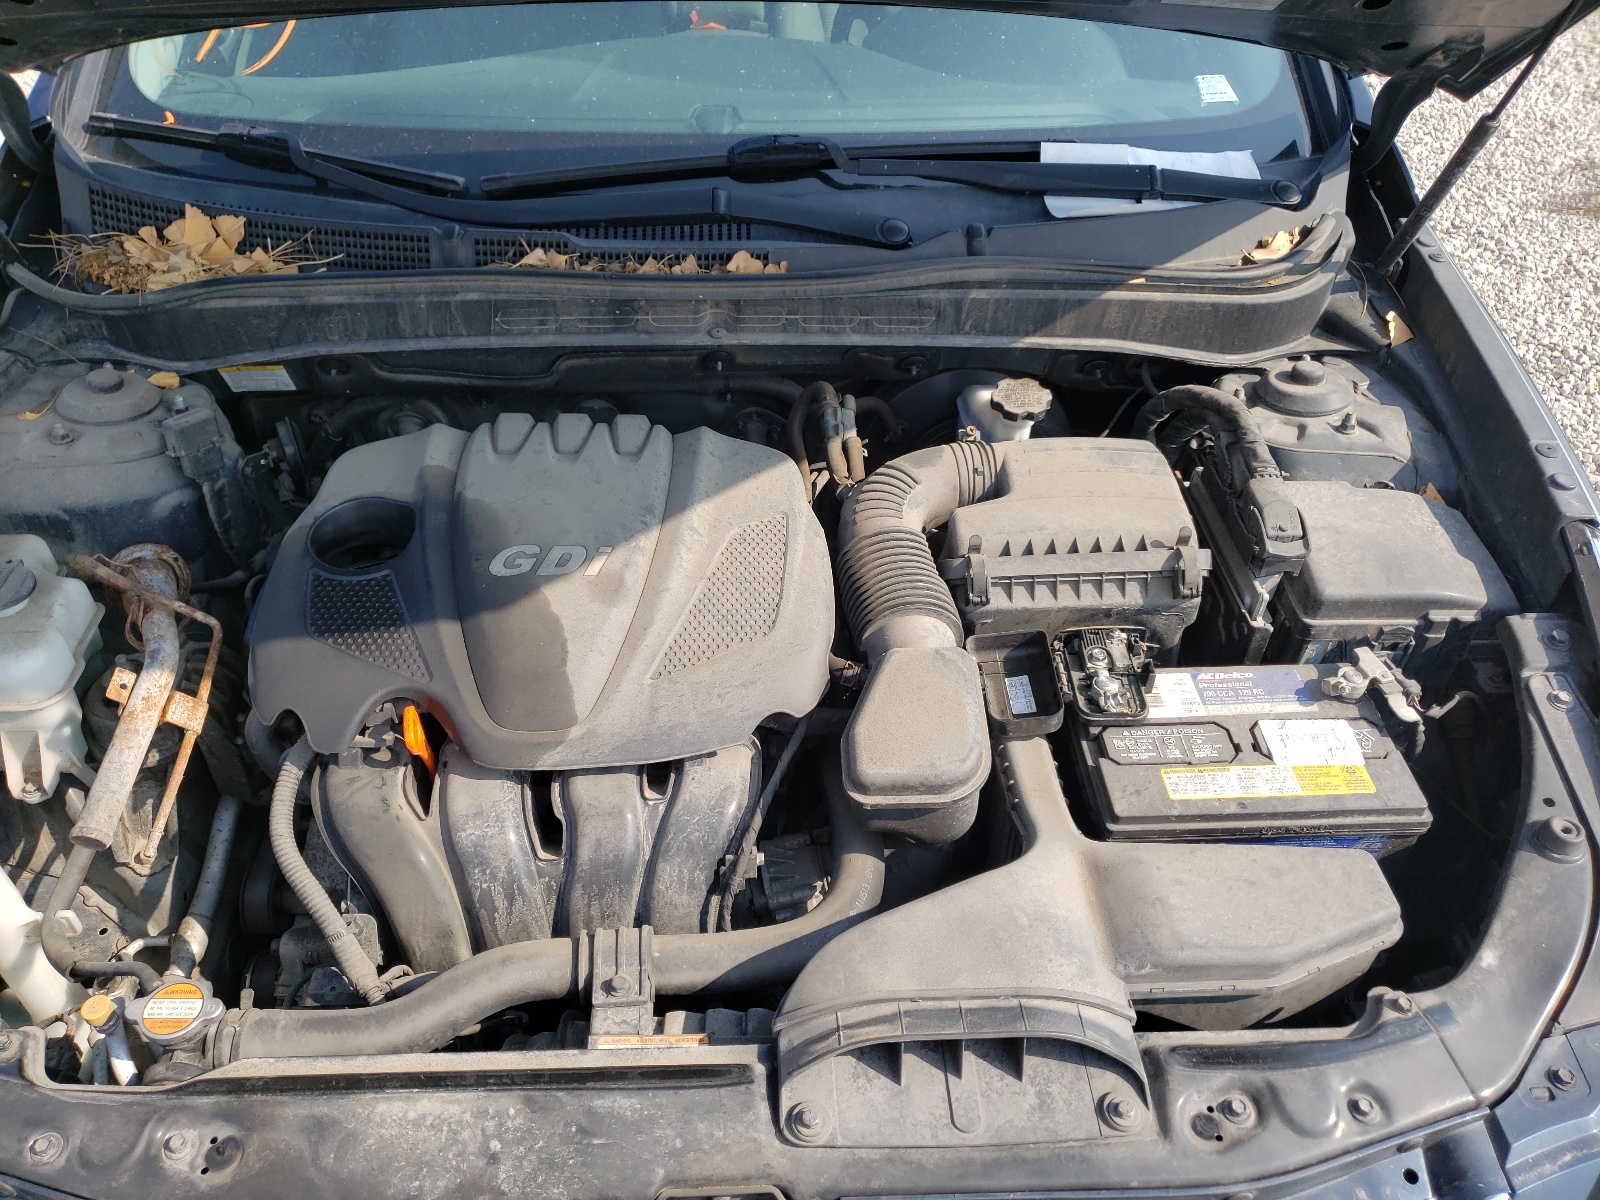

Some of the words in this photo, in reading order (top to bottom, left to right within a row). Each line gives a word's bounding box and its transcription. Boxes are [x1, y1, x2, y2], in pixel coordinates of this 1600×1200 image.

[488, 544, 614, 577] GDi
[1197, 672, 1254, 680] ACDelco
[1199, 681, 1253, 689] Professional
[1217, 689, 1235, 697] CCA
[1238, 688, 1252, 696] 120
[1253, 688, 1265, 696] RC
